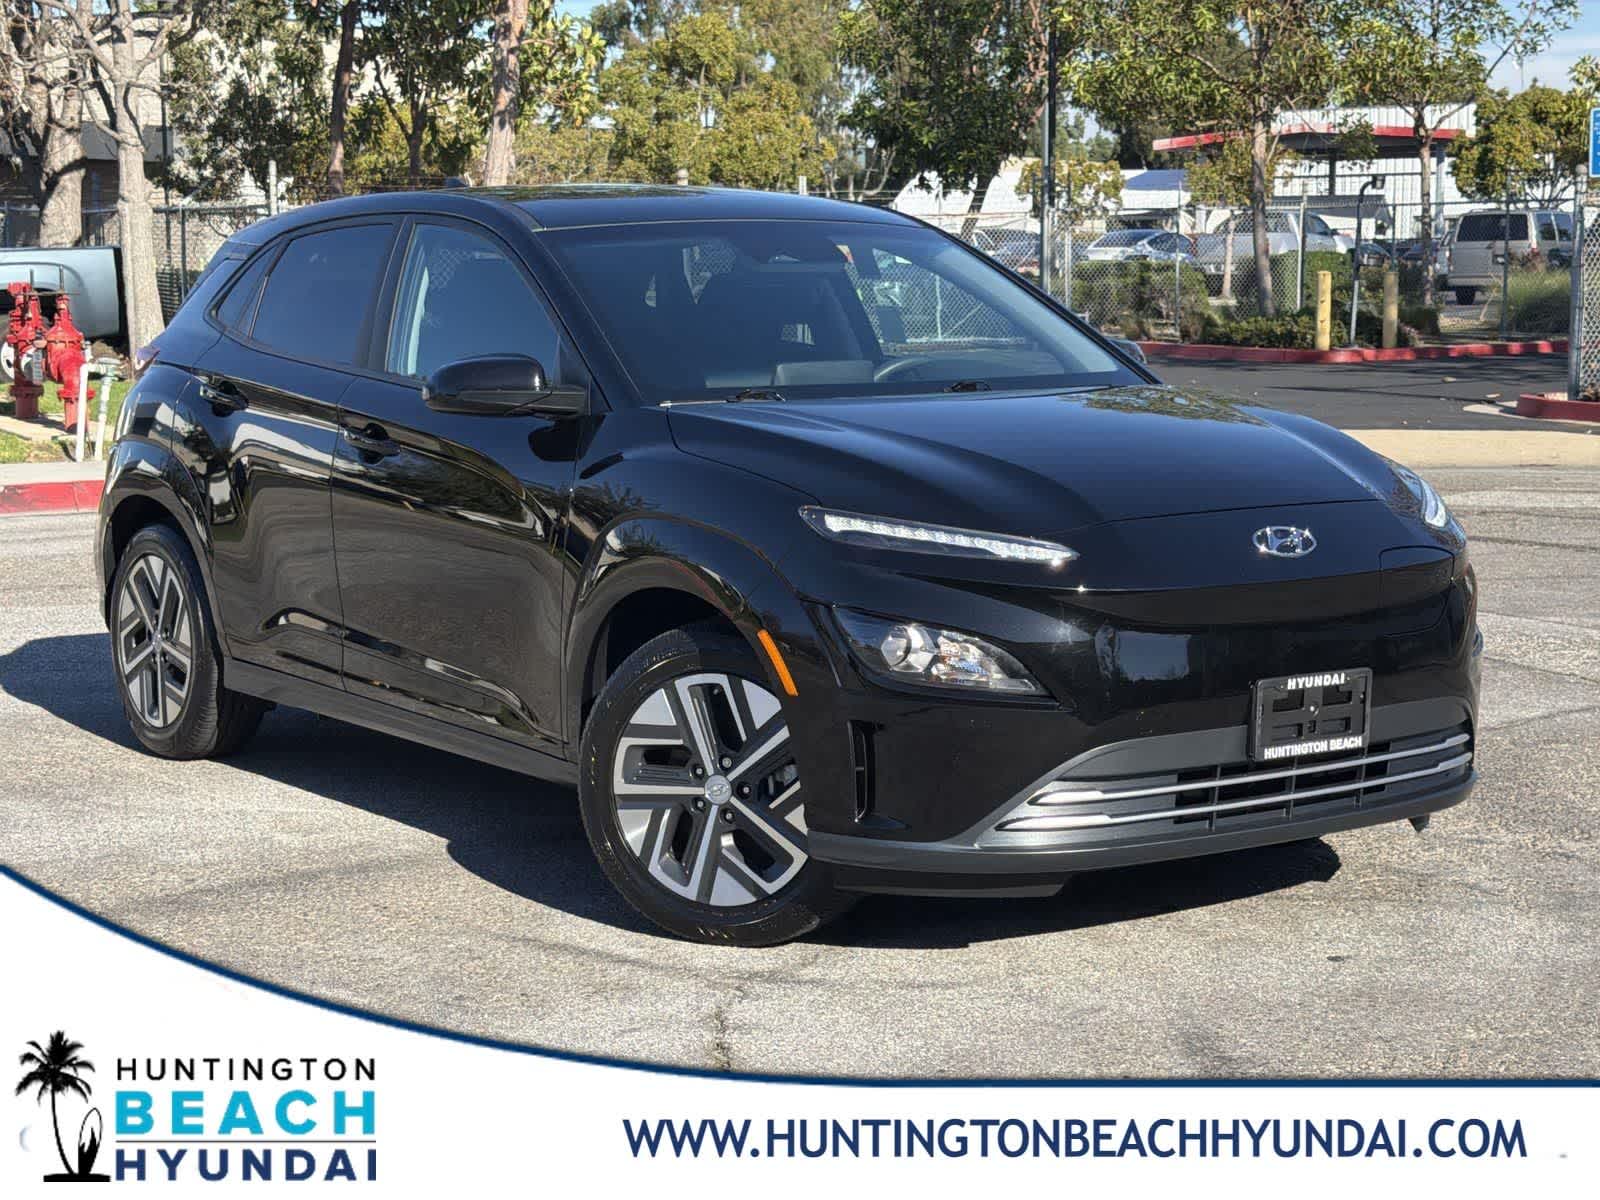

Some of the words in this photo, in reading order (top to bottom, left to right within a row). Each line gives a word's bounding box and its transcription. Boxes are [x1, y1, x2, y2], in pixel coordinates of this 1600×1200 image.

[1287, 672, 1346, 690] HYUNDAI
[1264, 739, 1328, 760] HUNTINGTON
[1329, 736, 1362, 750] BEACH
